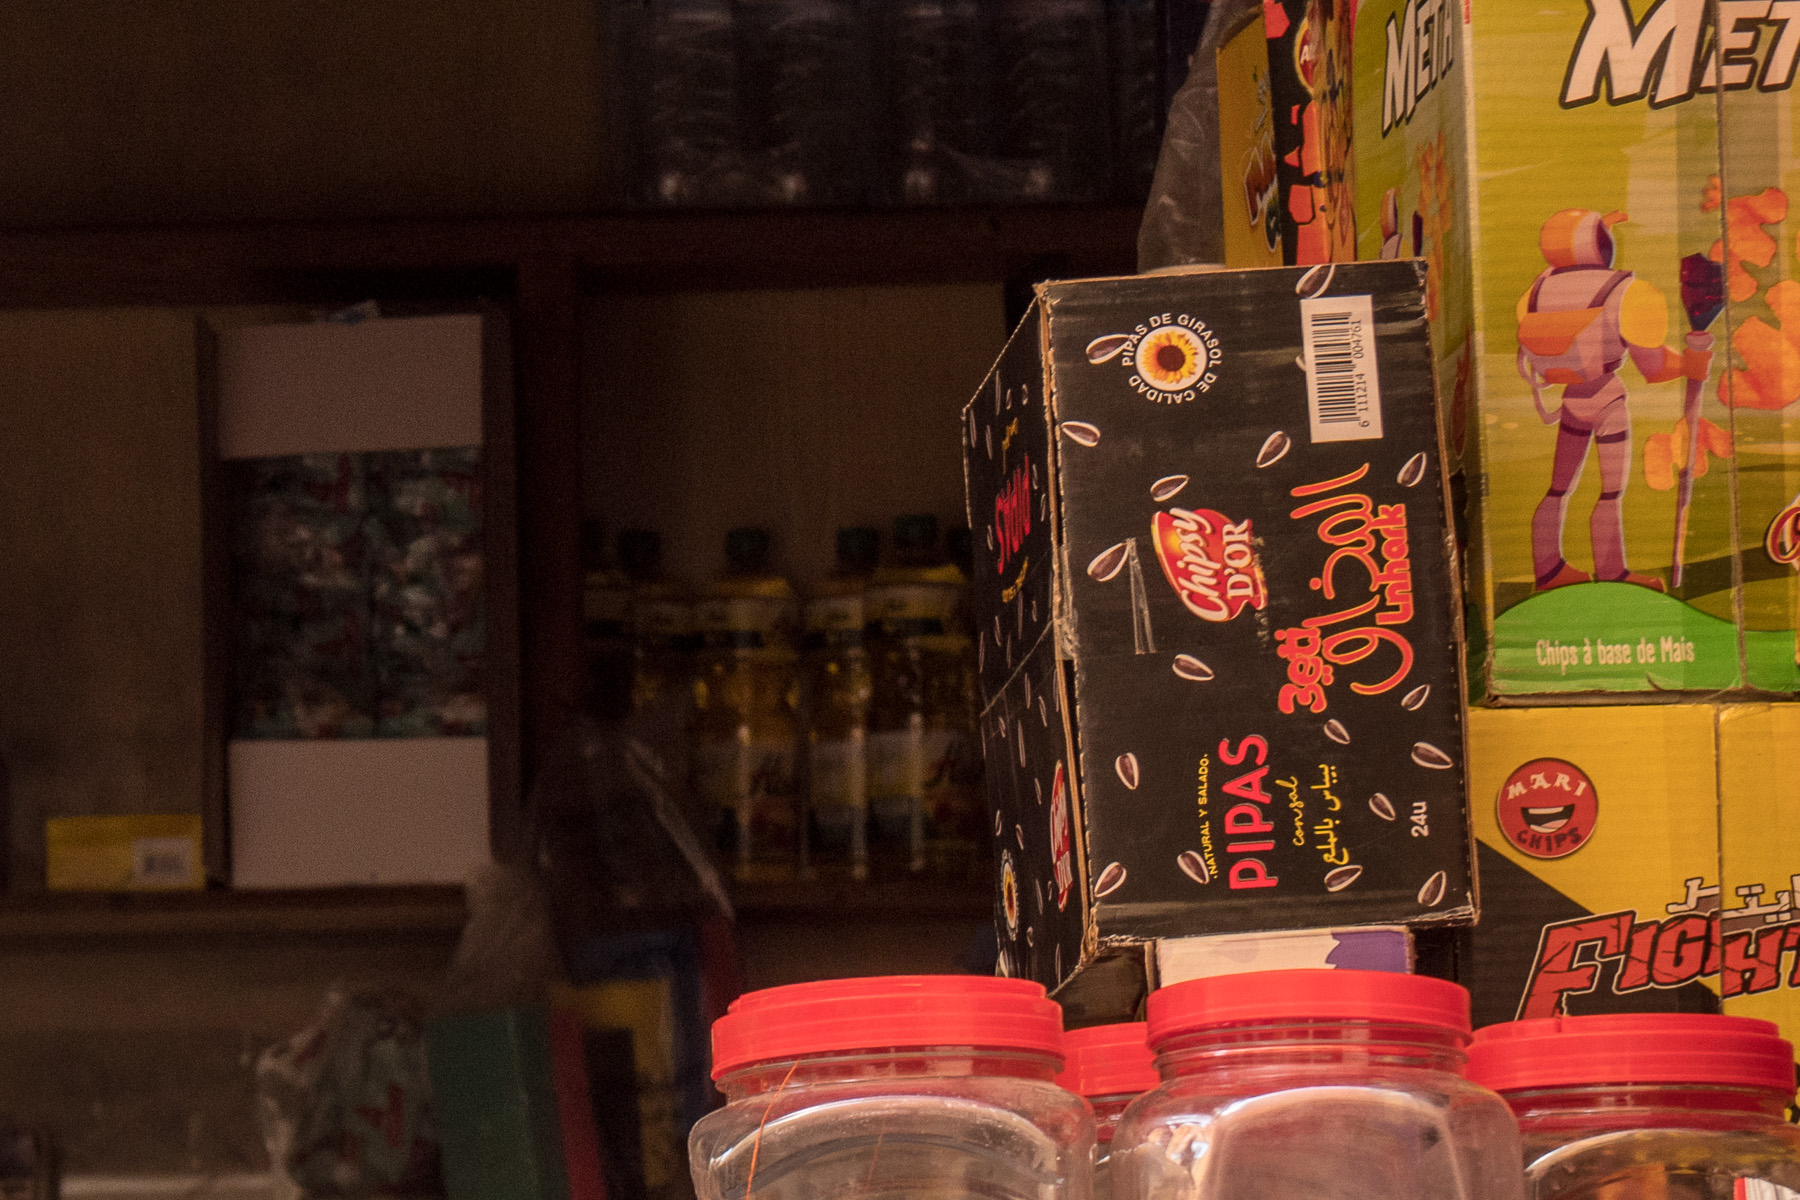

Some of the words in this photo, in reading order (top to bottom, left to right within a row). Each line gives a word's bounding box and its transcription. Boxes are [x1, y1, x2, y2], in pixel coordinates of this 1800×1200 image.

[1149, 313, 1172, 327] DE
[1351, 319, 1364, 359] 004761
[1121, 324, 1148, 366] PIPAS
[1177, 314, 1222, 367] GIRASOL
[1128, 375, 1196, 404] CALIDAD
[1196, 372, 1218, 393] DE
[1355, 373, 1368, 412] 111214
[1359, 420, 1370, 428] 6
[1169, 507, 1228, 621] Chipsy
[1222, 519, 1254, 599] D'OR
[1290, 462, 1413, 695] المذاق
[1536, 639, 1578, 676] Chips
[1583, 637, 1592, 664] à
[1597, 638, 1632, 665] base
[1637, 637, 1655, 663] de
[1506, 772, 1587, 800] MARI
[1199, 809, 1208, 817] Y
[1218, 734, 1279, 889] PIPAS
[1410, 801, 1429, 837] 24u
[1517, 827, 1582, 852] CHIPS
